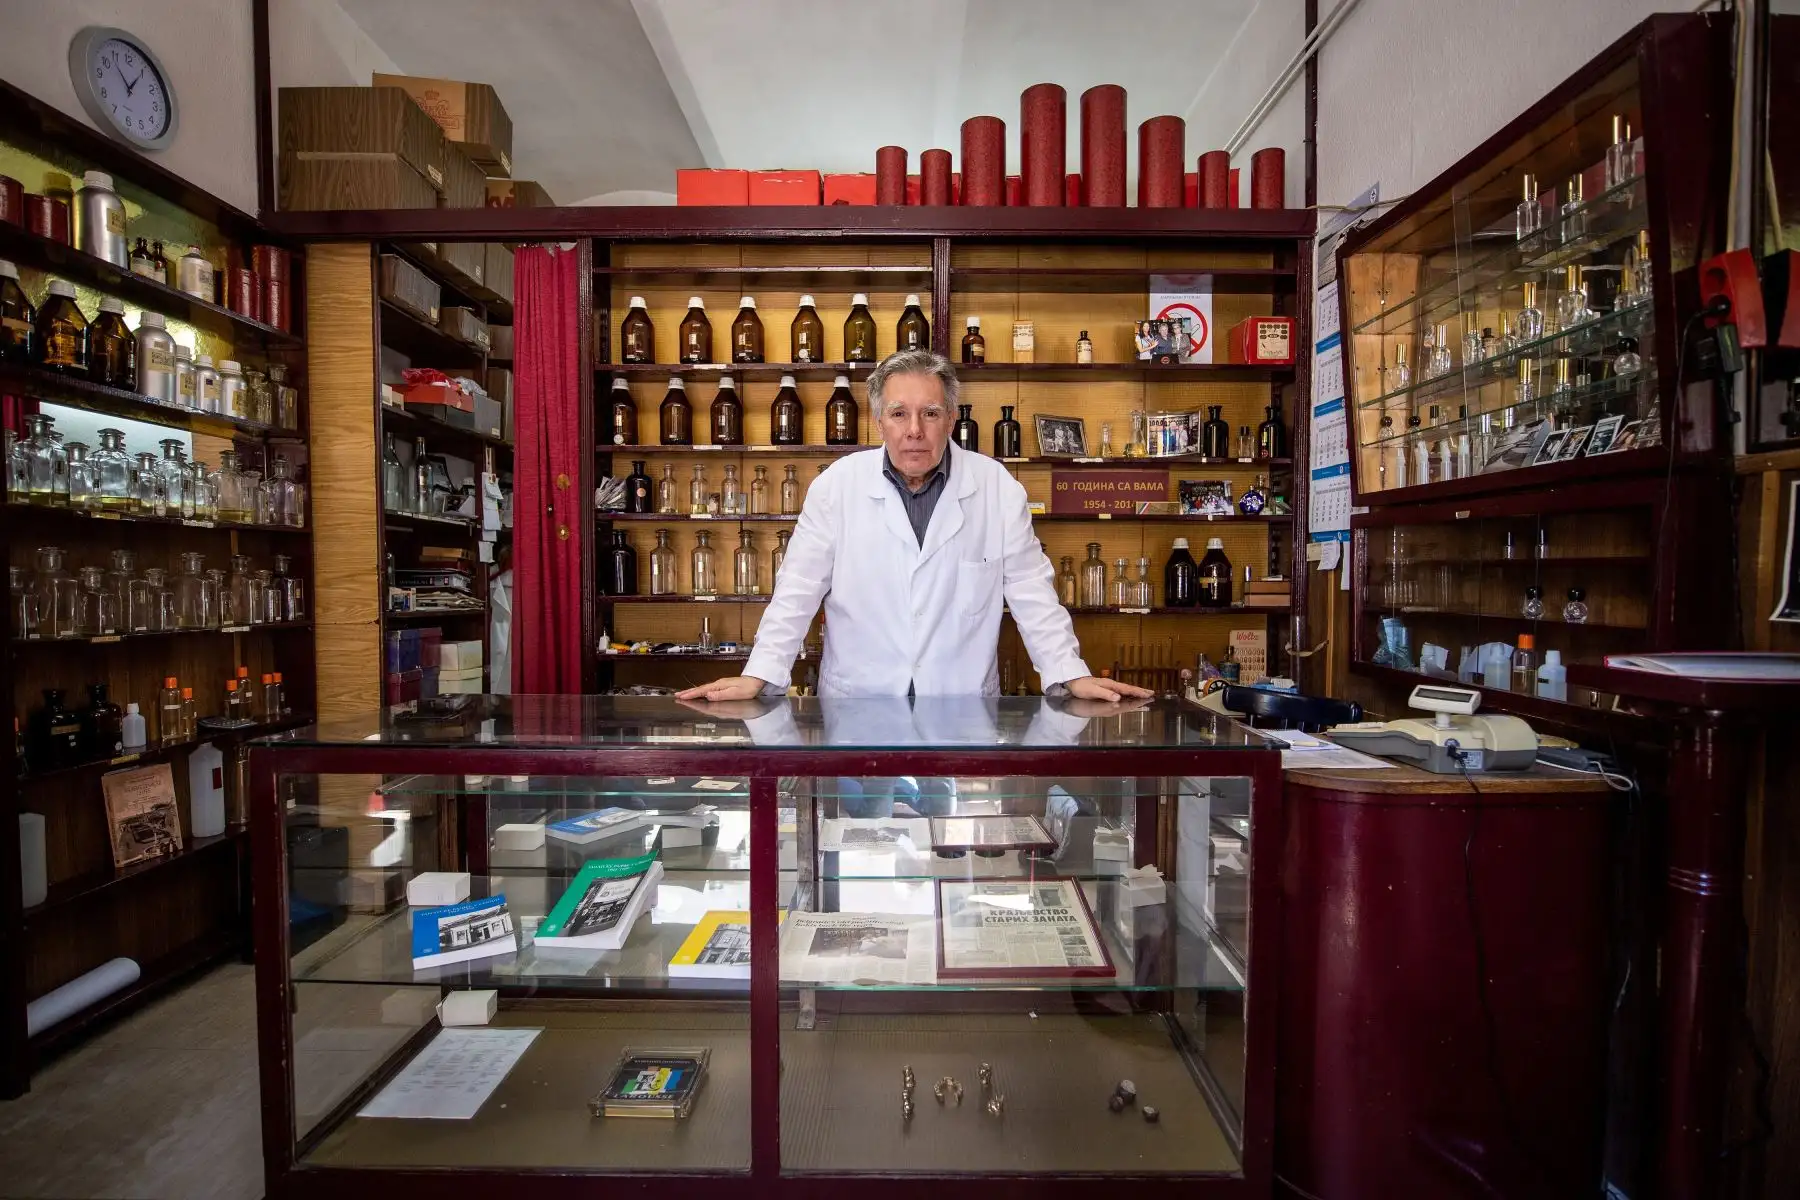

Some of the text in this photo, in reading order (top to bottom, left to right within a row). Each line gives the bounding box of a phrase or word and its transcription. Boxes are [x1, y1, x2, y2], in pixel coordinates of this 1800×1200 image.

[112, 50, 119, 63] 11
[124, 53, 133, 68] 12
[101, 56, 111, 69] 10
[96, 67, 103, 78] 9
[101, 86, 108, 99] 8
[148, 84, 155, 96] 2
[111, 103, 118, 114] 7
[152, 101, 159, 112] 3
[125, 115, 132, 127] 6
[138, 119, 145, 130] 5
[148, 115, 154, 125] 4
[1056, 481, 1164, 492] 60 ГОДИНА СА ВАМА
[1083, 500, 1106, 509] 1954
[990, 908, 1068, 916] КРАЉЕВСТВО
[984, 915, 1078, 923] СТАРИХ ЗАНАТА
